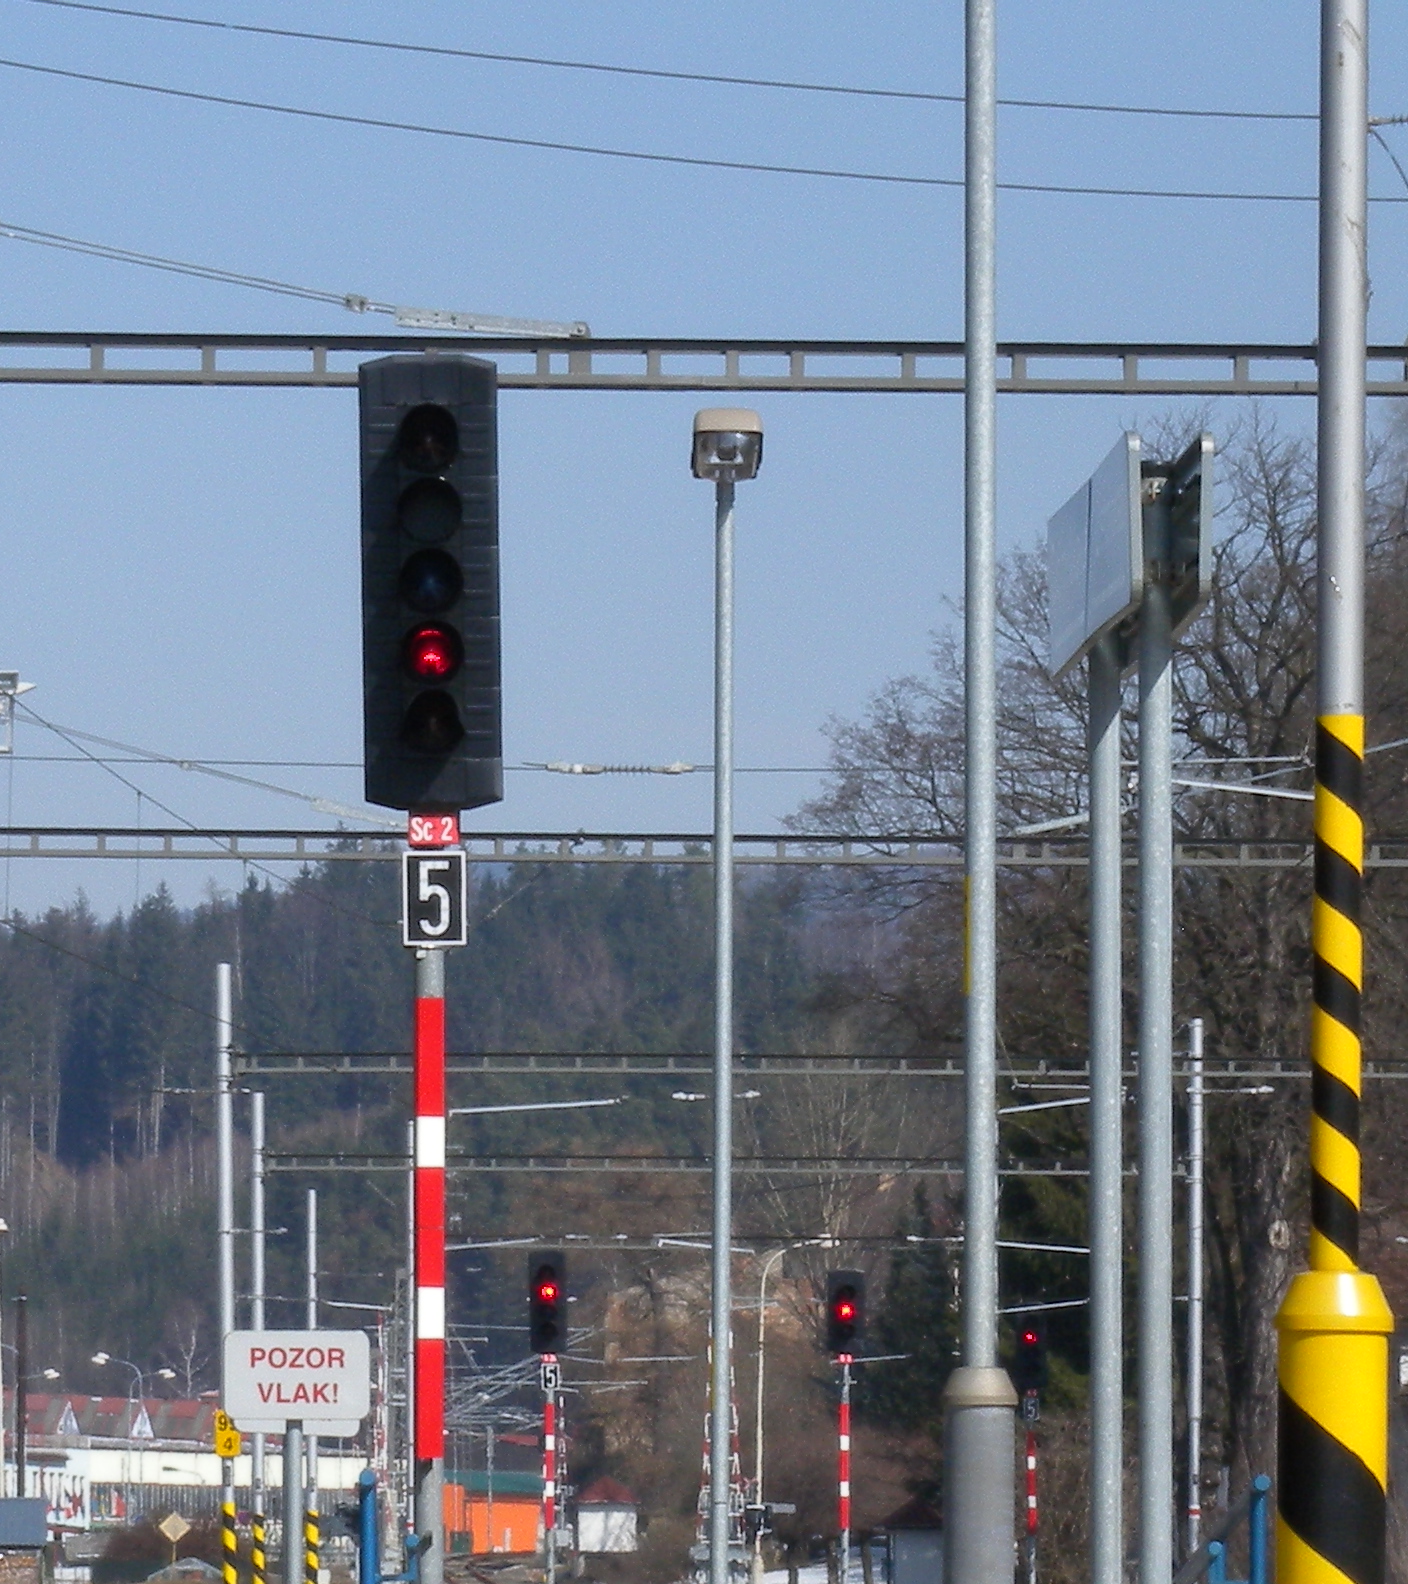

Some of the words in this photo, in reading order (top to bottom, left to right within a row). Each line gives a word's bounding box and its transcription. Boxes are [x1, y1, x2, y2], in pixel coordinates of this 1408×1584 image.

[411, 817, 433, 841] Sc
[441, 817, 453, 841] 2
[419, 860, 450, 936] 5
[250, 1347, 345, 1368] POZOR
[546, 1366, 556, 1388] 5
[257, 1383, 339, 1404] VLAK!
[1027, 1400, 1035, 1418] 5
[218, 1415, 235, 1431] 9
[223, 1437, 233, 1451] 4
